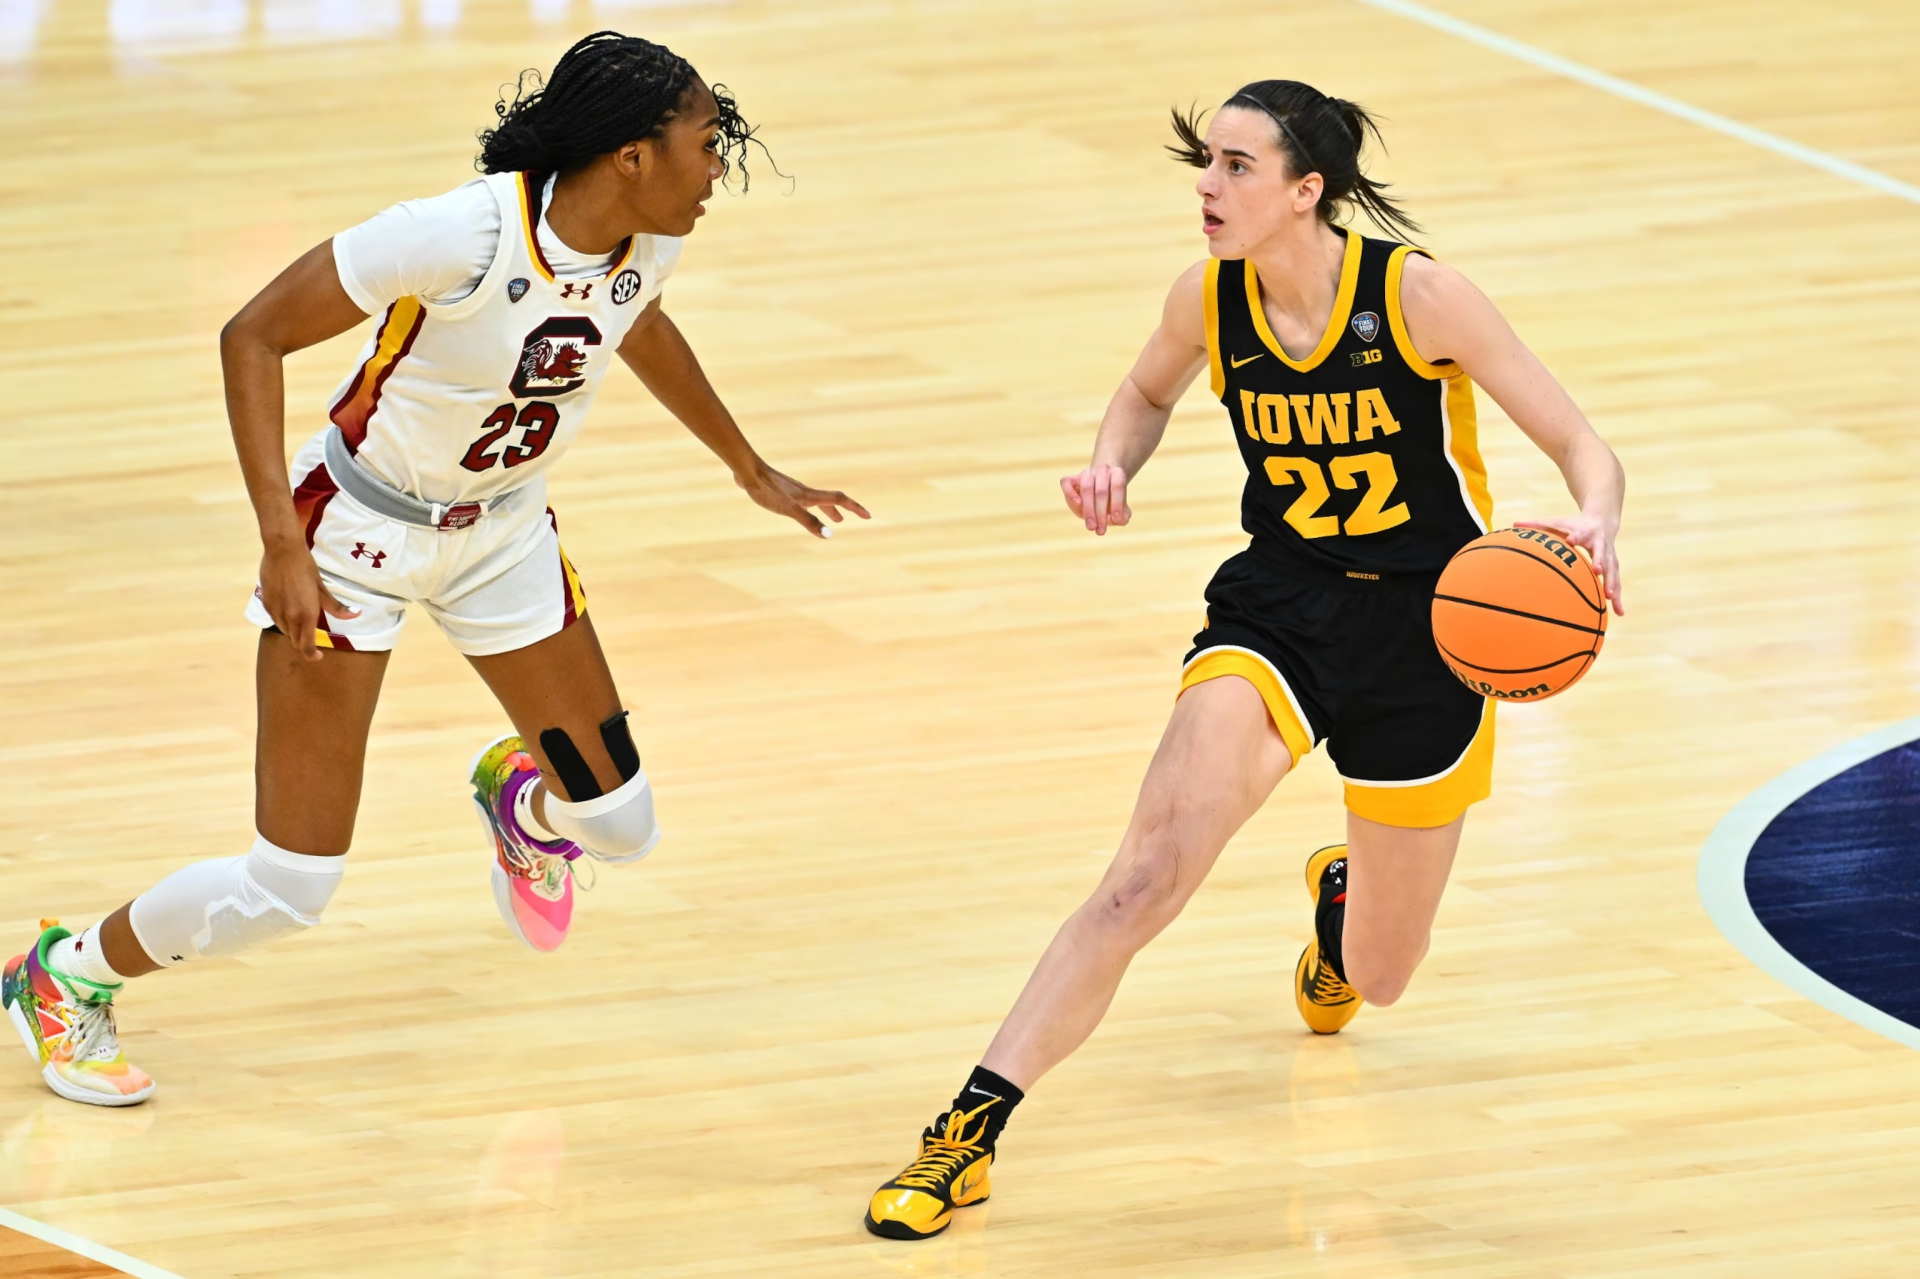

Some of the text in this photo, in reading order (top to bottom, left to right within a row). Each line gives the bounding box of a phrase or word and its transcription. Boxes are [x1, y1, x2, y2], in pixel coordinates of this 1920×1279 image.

[614, 272, 639, 303] SEC
[459, 400, 560, 473] 23
[1239, 387, 1402, 446] IOWA
[1263, 451, 1411, 540] 22
[1511, 528, 1577, 568] Wils
[1346, 571, 1380, 580] HAWKEYES
